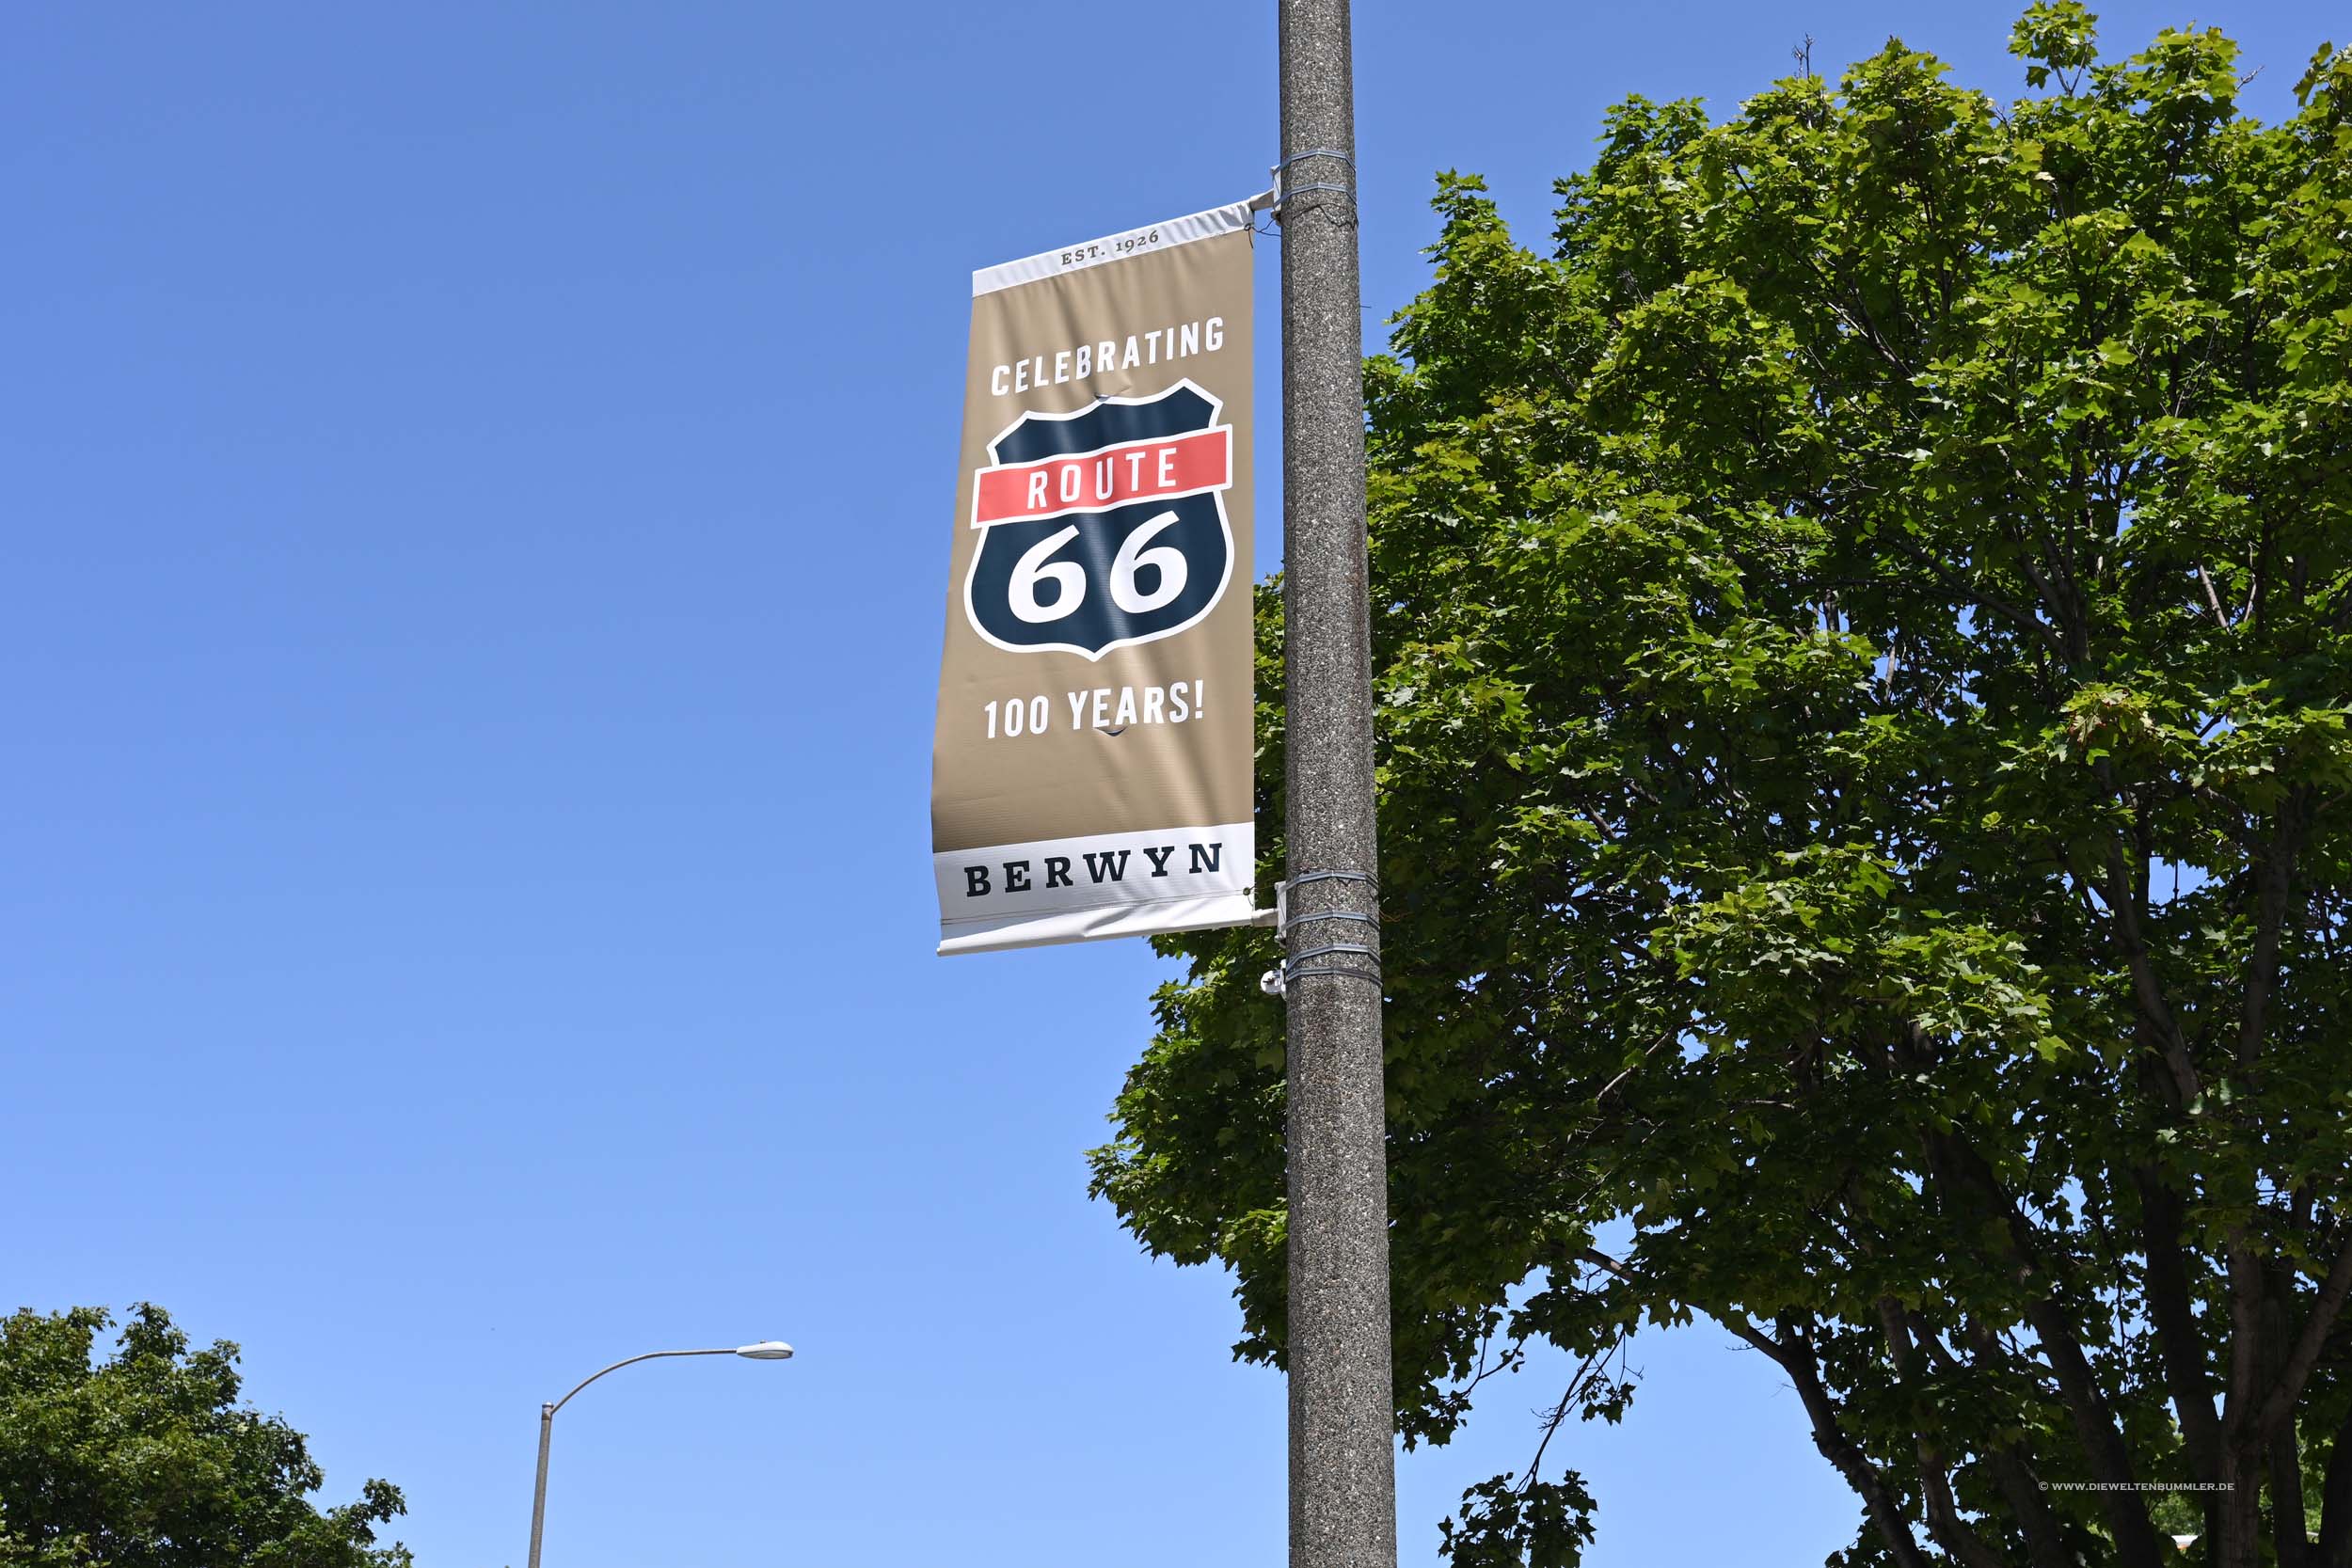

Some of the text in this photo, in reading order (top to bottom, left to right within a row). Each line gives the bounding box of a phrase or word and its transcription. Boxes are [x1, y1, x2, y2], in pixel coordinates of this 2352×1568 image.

[1061, 230, 1160, 266] EST. 1926
[991, 316, 1224, 397] CELEBRATING
[1026, 447, 1178, 510] ROUTE
[1008, 510, 1189, 624] 66
[984, 679, 1204, 739] 100 YEARS!
[963, 842, 1223, 898] BERWYN
